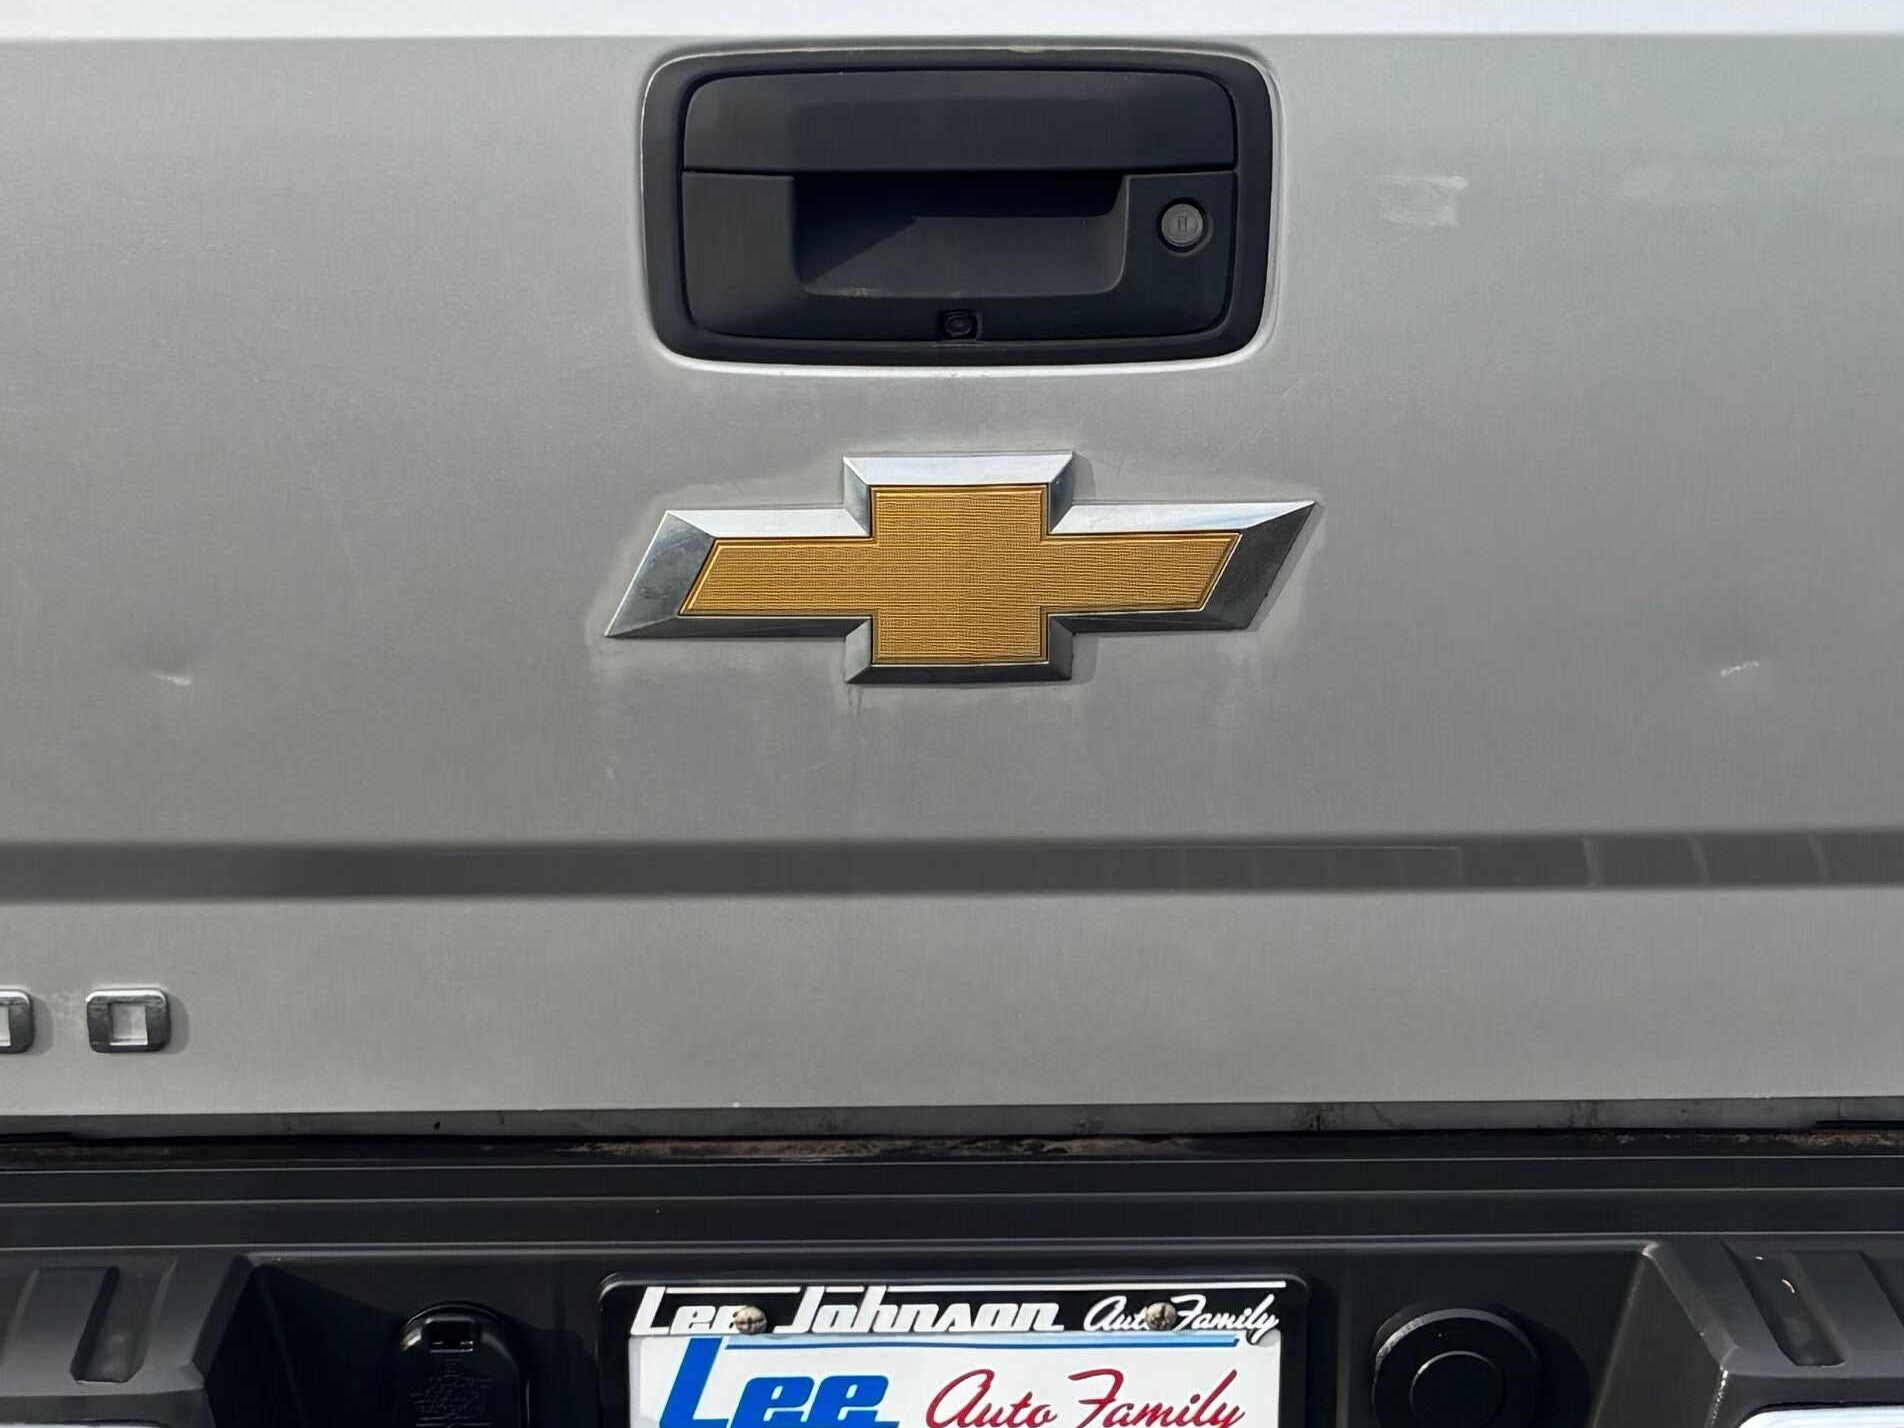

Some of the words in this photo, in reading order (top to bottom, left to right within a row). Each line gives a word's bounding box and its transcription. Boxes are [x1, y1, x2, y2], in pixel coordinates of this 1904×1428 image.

[772, 1285, 1065, 1334] Johnson
[1083, 1295, 1154, 1332] Aut
[1170, 1294, 1280, 1344] Family
[926, 1368, 1058, 1428] Auto
